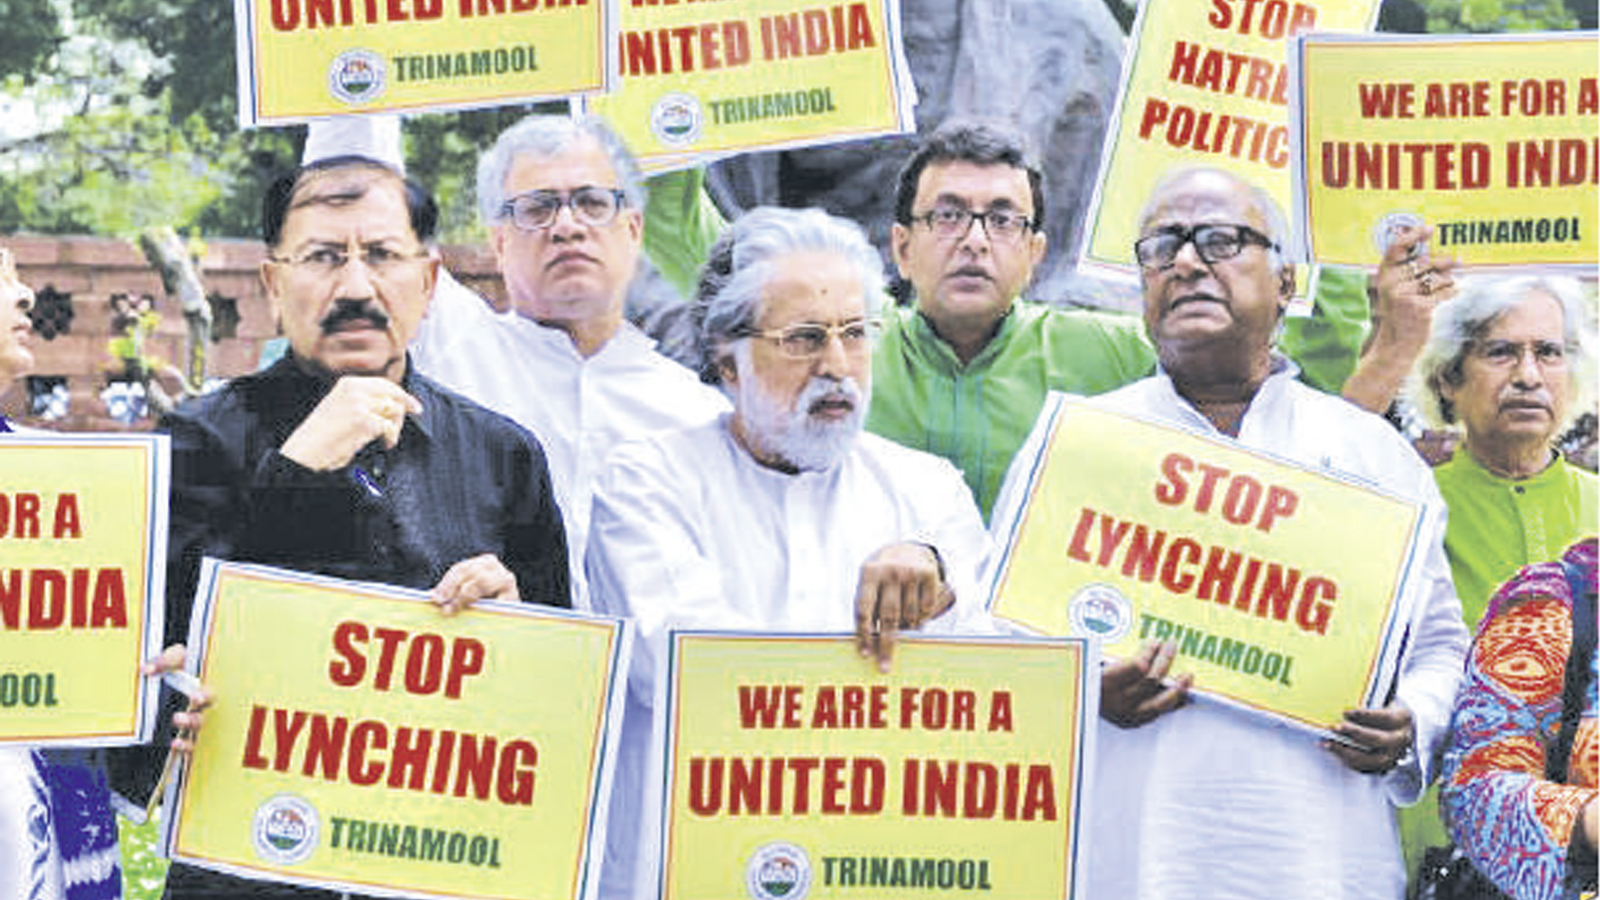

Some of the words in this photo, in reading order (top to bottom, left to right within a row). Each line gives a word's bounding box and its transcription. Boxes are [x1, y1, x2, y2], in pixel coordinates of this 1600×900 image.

[619, 22, 749, 75] NITED
[761, 4, 873, 60] INDIA
[1209, 0, 1314, 39] STOP
[392, 46, 538, 82] TRINAMOOL
[711, 88, 836, 124] TRINAMOOL
[1360, 84, 1413, 117] WE
[1425, 82, 1488, 116] ARE
[1502, 80, 1566, 116] FOR
[1578, 78, 1598, 114] A
[1322, 143, 1490, 190] UNITED
[1437, 217, 1581, 246] TRINAMOOL
[1155, 453, 1299, 532] STOP
[54, 494, 80, 539] A
[1067, 507, 1338, 636] LYNCHING
[0, 569, 127, 630] NDIA
[739, 686, 801, 728] WE
[813, 686, 887, 728] ARE
[901, 688, 975, 730] FOR
[989, 692, 1012, 730] A
[242, 705, 537, 806] LYNCHING
[689, 758, 885, 816] UNITED
[903, 759, 1056, 821] INDIA
[331, 818, 499, 867] TRINAMOOL
[823, 857, 991, 890] TRINAMOOL
